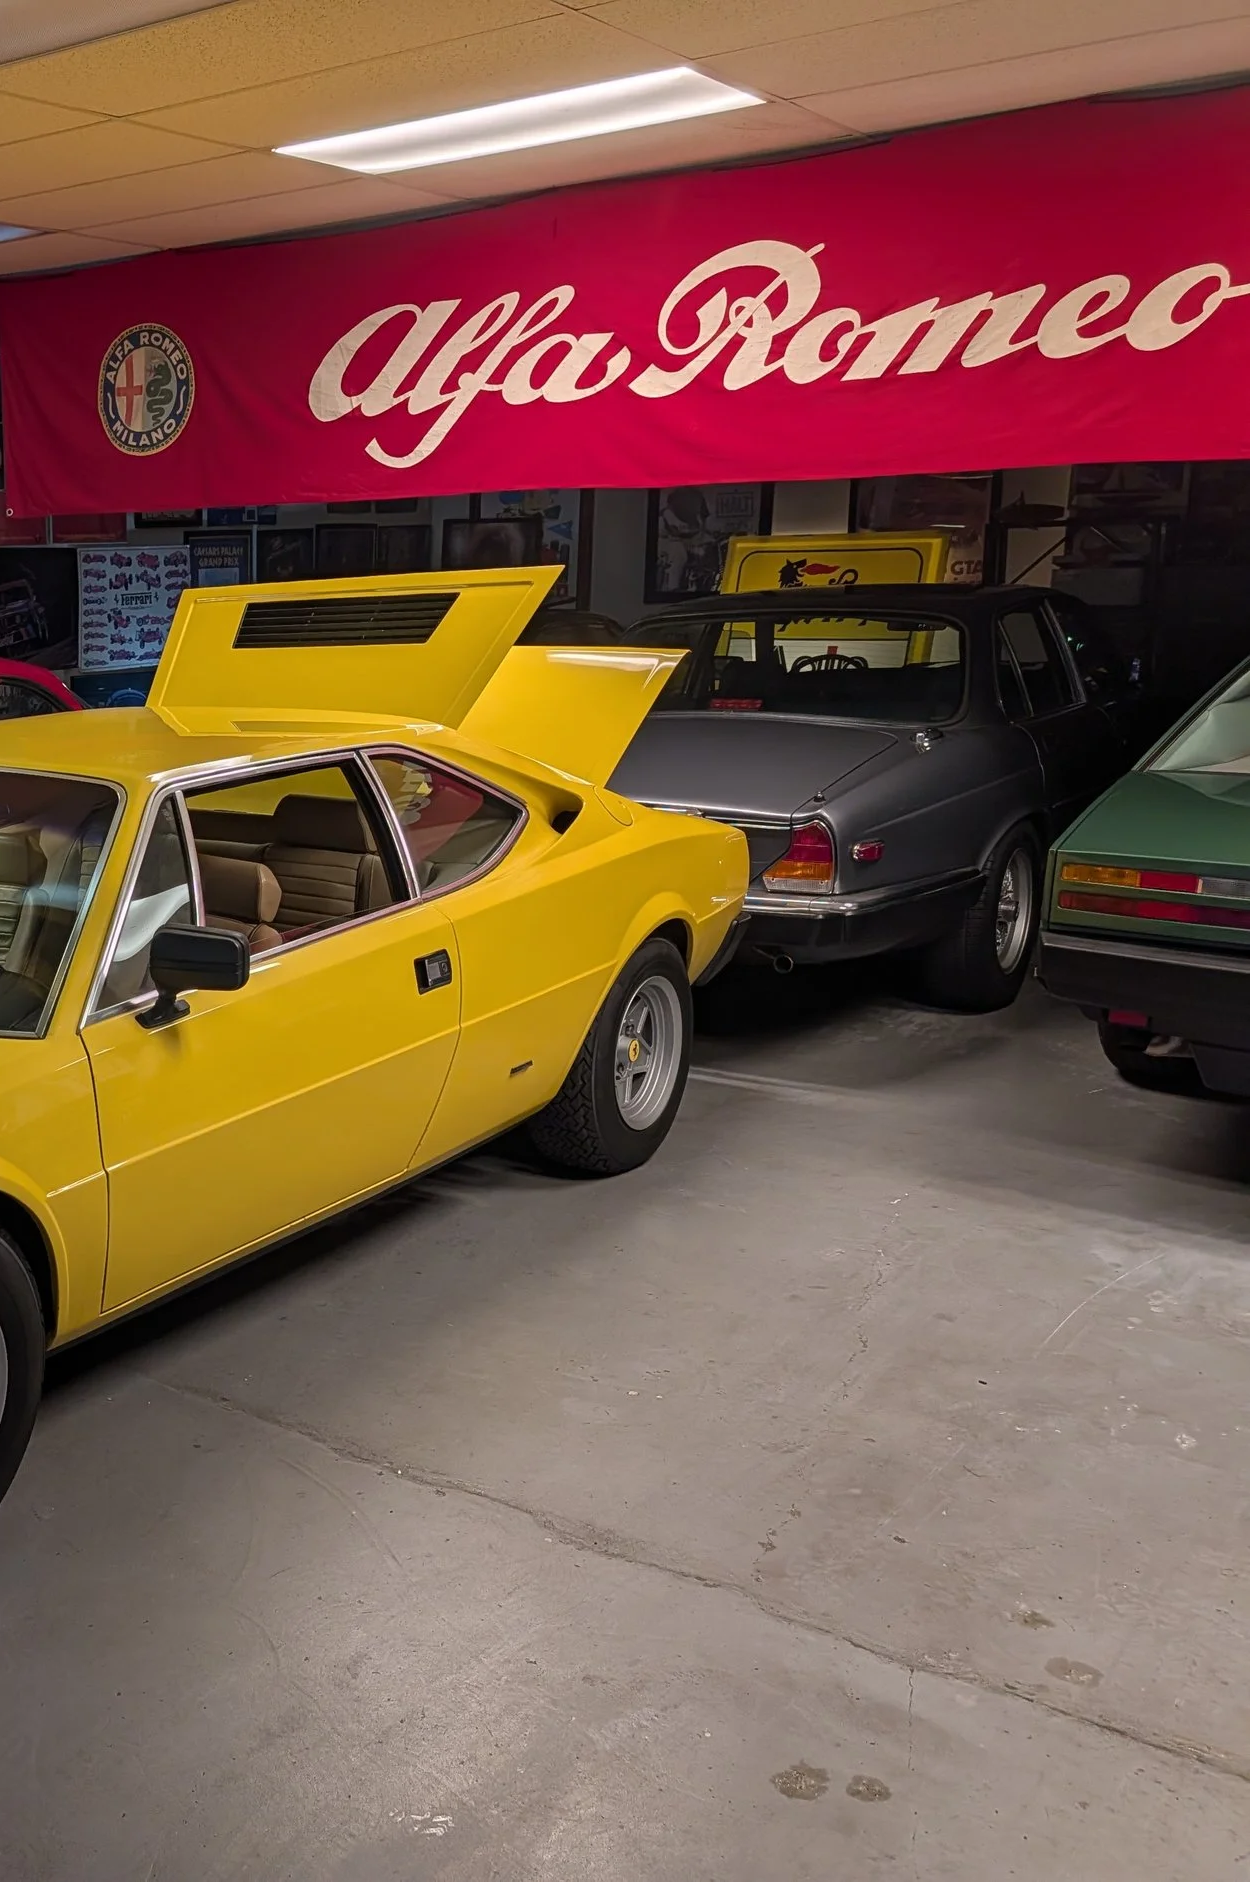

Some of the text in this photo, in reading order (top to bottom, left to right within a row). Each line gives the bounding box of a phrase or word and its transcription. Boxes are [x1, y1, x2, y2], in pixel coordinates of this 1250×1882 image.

[105, 331, 188, 385] ALFA ROMEO
[308, 239, 1250, 468] Alfa Romeo
[112, 418, 177, 447] MILANO
[198, 556, 239, 568] GRAND PRIX
[120, 592, 153, 606] Ferrari
